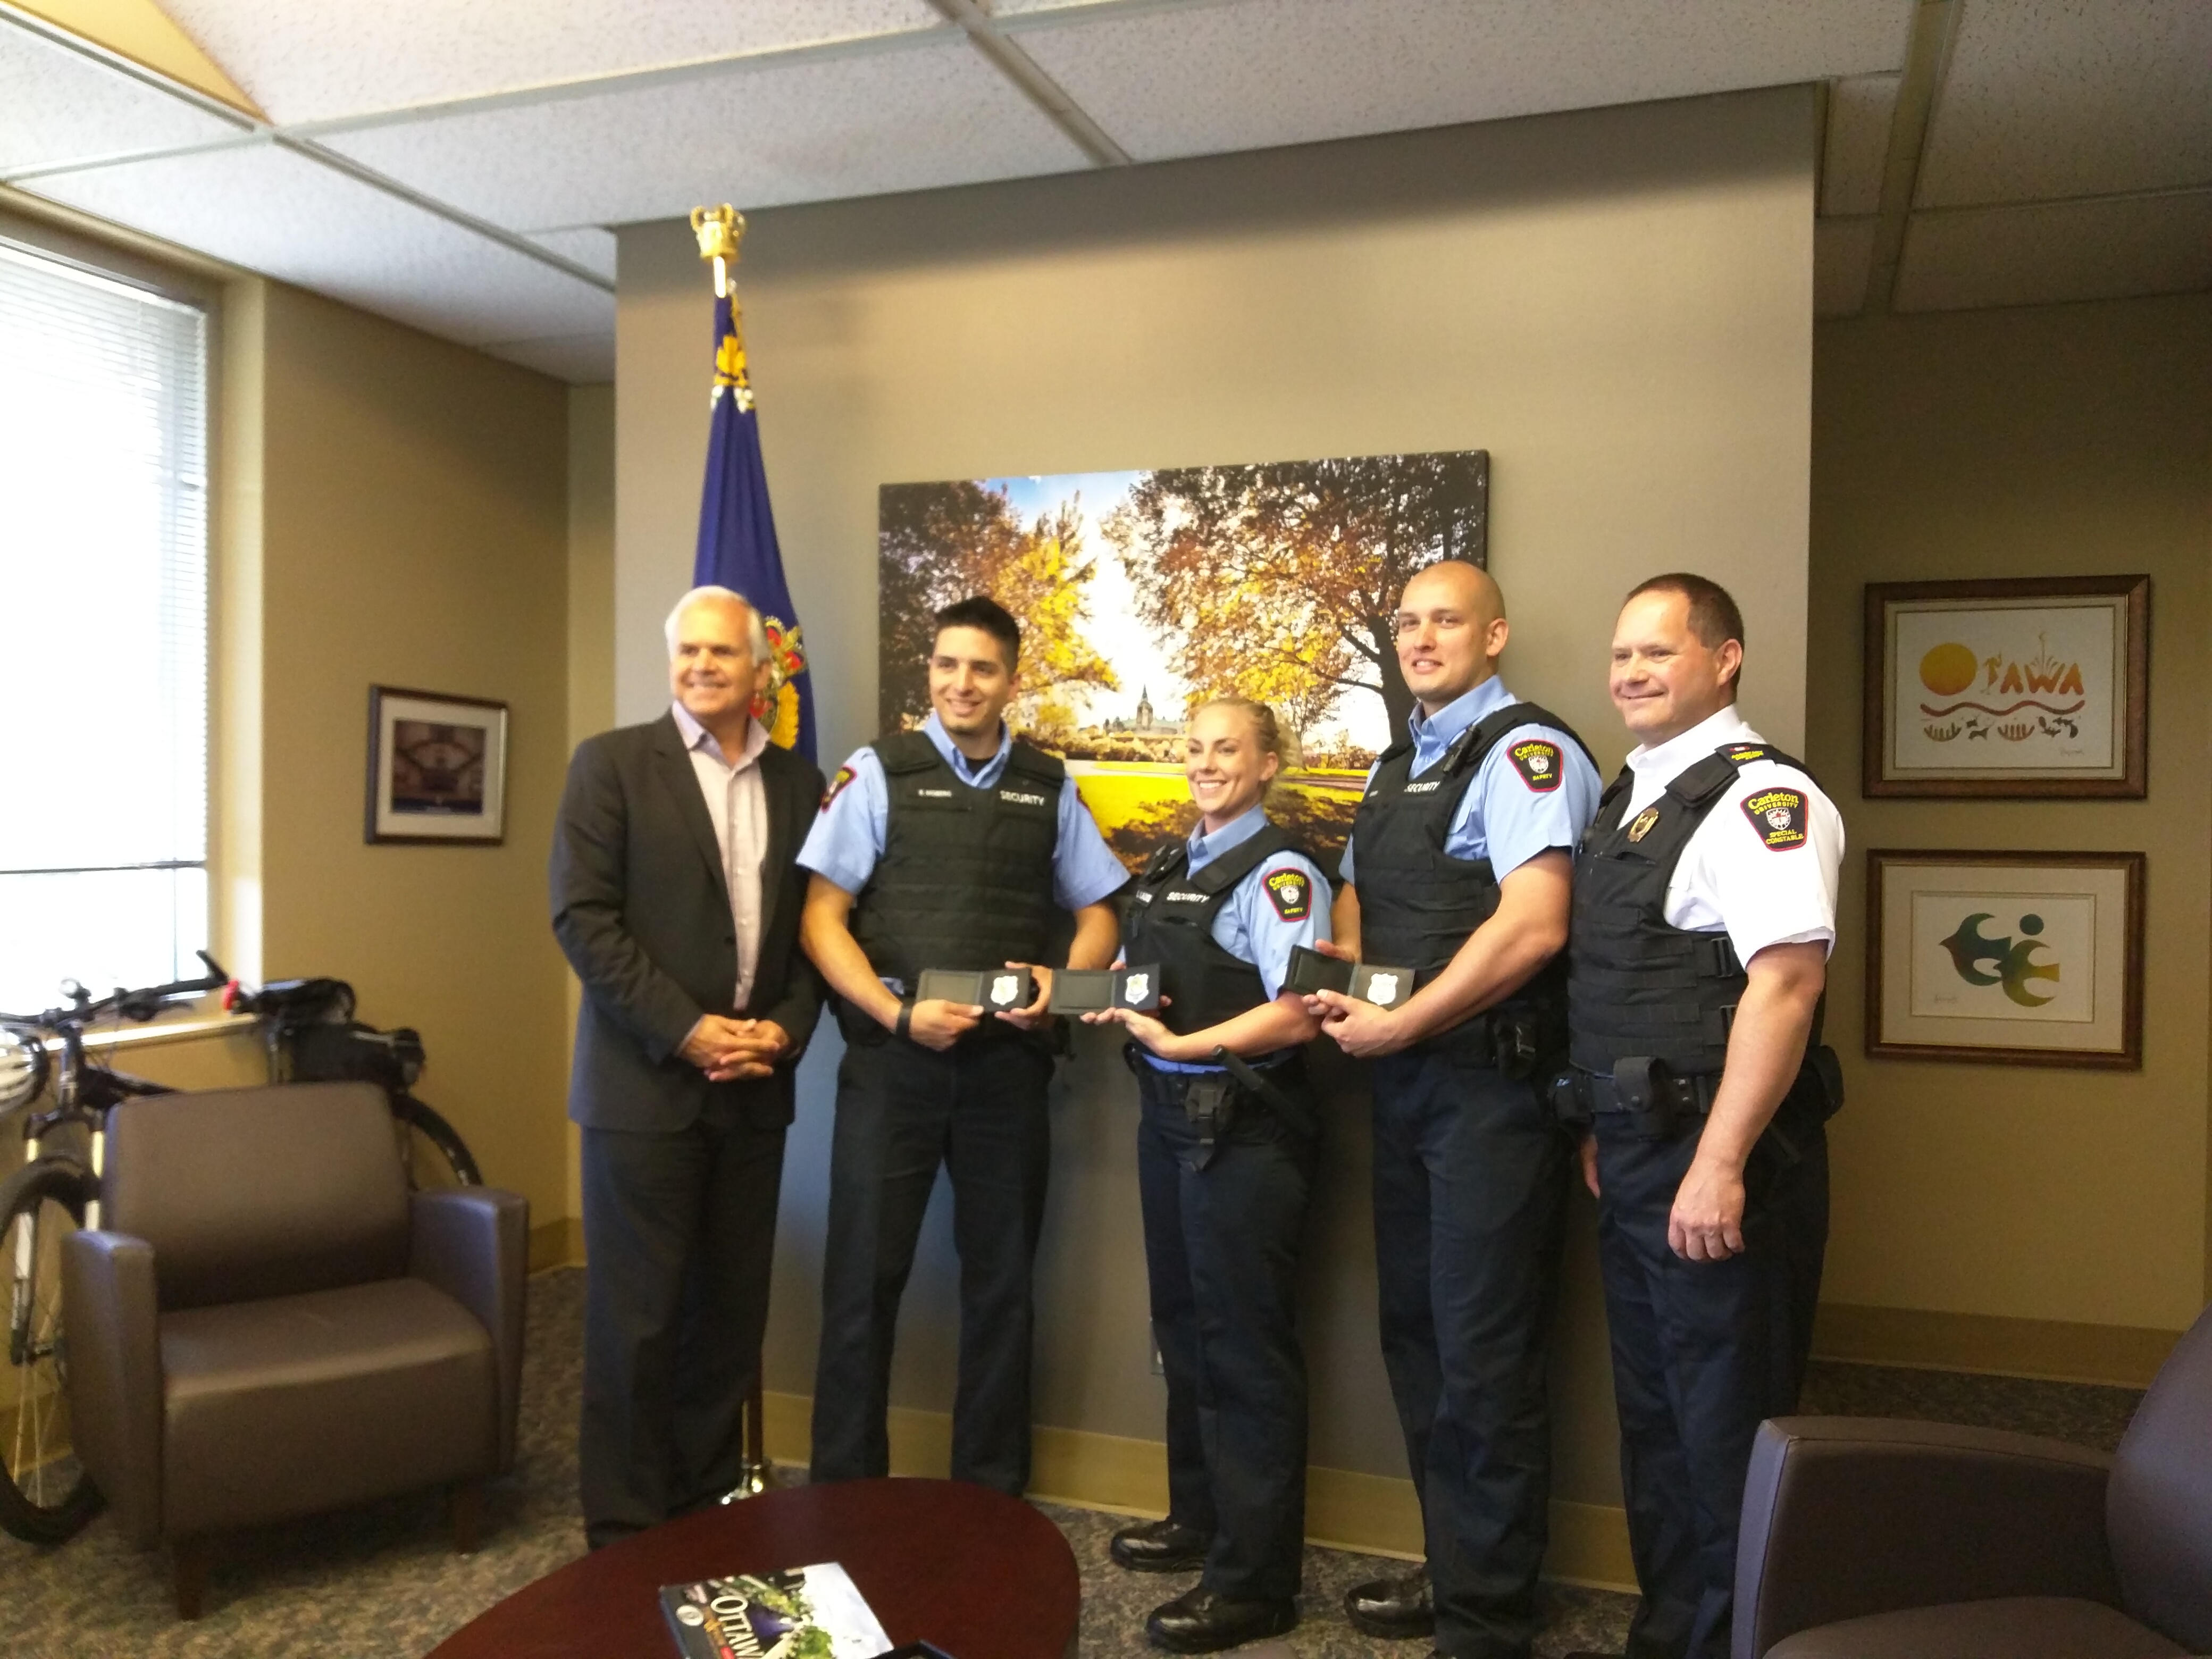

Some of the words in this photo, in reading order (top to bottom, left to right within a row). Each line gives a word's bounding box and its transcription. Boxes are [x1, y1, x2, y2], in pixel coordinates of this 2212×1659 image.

[1514, 743, 1554, 757] Carleton
[1404, 781, 1440, 792] SECURITY
[999, 790, 1045, 806] SECURITY
[1748, 792, 1799, 809] Carleton
[1754, 801, 1798, 815] UNIVERSITY
[1766, 833, 1804, 844] CONSTABLE
[1769, 829, 1797, 838] SPECIAL
[1269, 873, 1305, 887] Carleton
[1167, 892, 1211, 903] SECURITY
[710, 1595, 767, 1659] OTTAW
